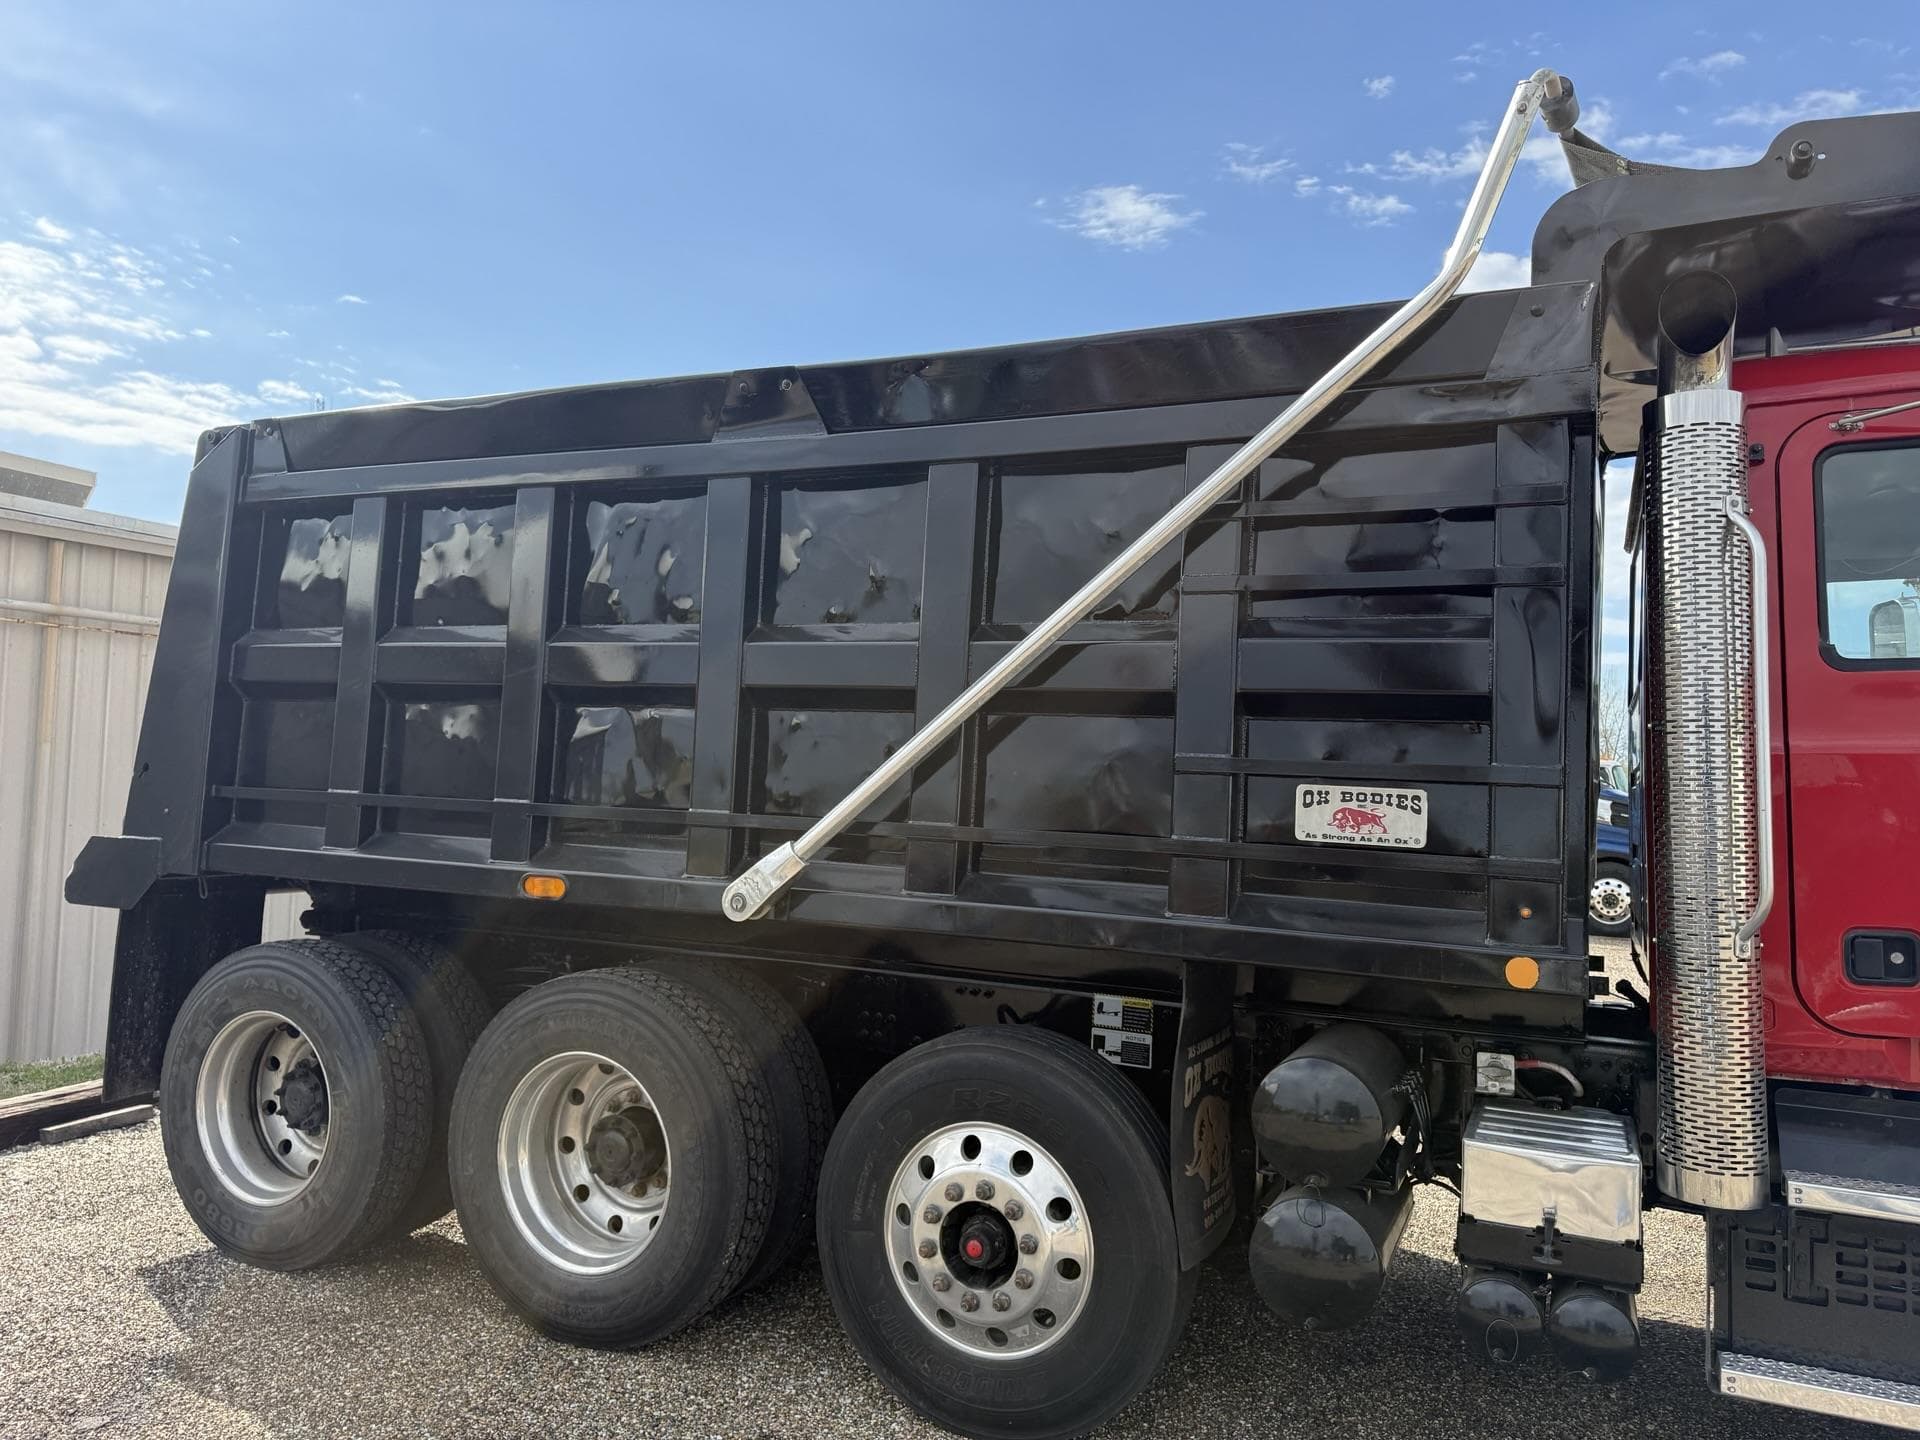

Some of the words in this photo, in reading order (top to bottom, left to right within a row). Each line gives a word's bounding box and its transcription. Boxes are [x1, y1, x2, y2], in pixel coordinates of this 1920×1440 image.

[1302, 790, 1330, 808] OX
[1340, 791, 1422, 815] BODIES
[1321, 833, 1355, 842] Strong
